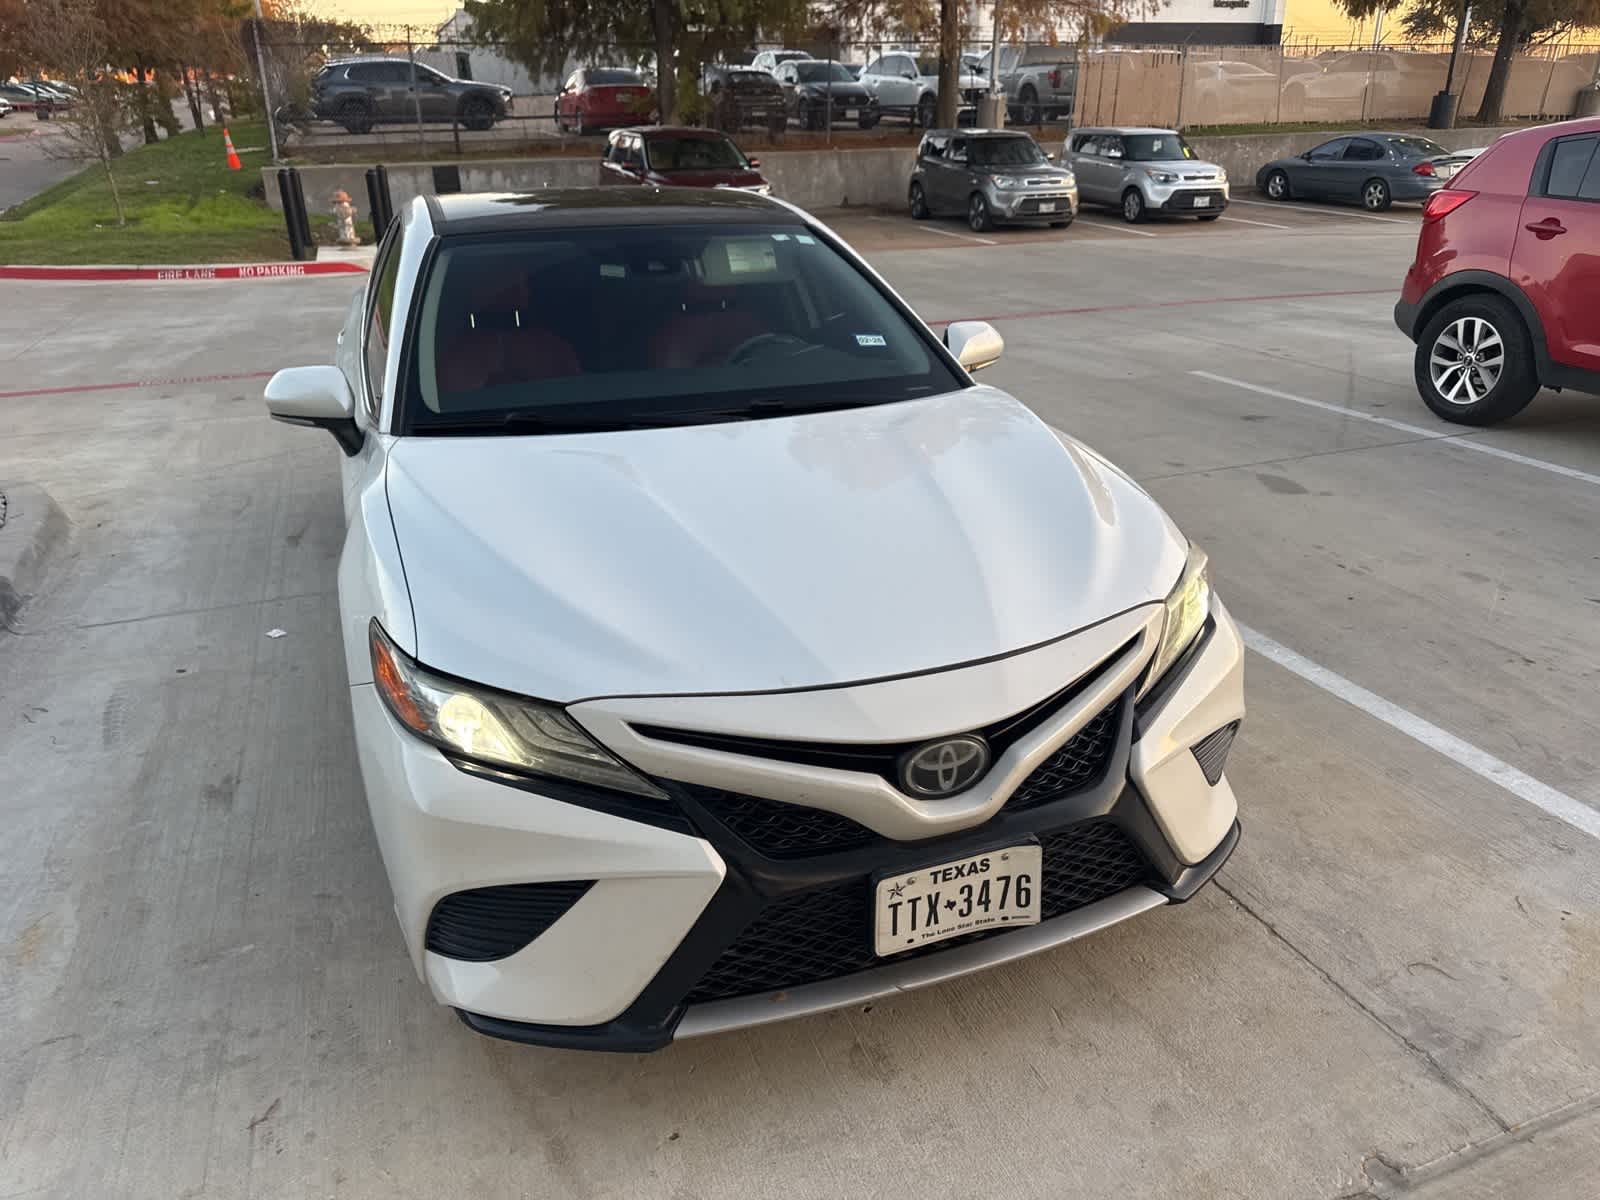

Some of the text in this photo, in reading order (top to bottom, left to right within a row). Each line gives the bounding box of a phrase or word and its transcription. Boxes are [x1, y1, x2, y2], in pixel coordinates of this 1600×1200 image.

[157, 269, 184, 281] FIRE
[239, 264, 305, 279] NO PARKING
[930, 858, 990, 885] TEXAS
[888, 874, 1032, 937] TTX 3476
[921, 917, 996, 939] The Lone Star State
